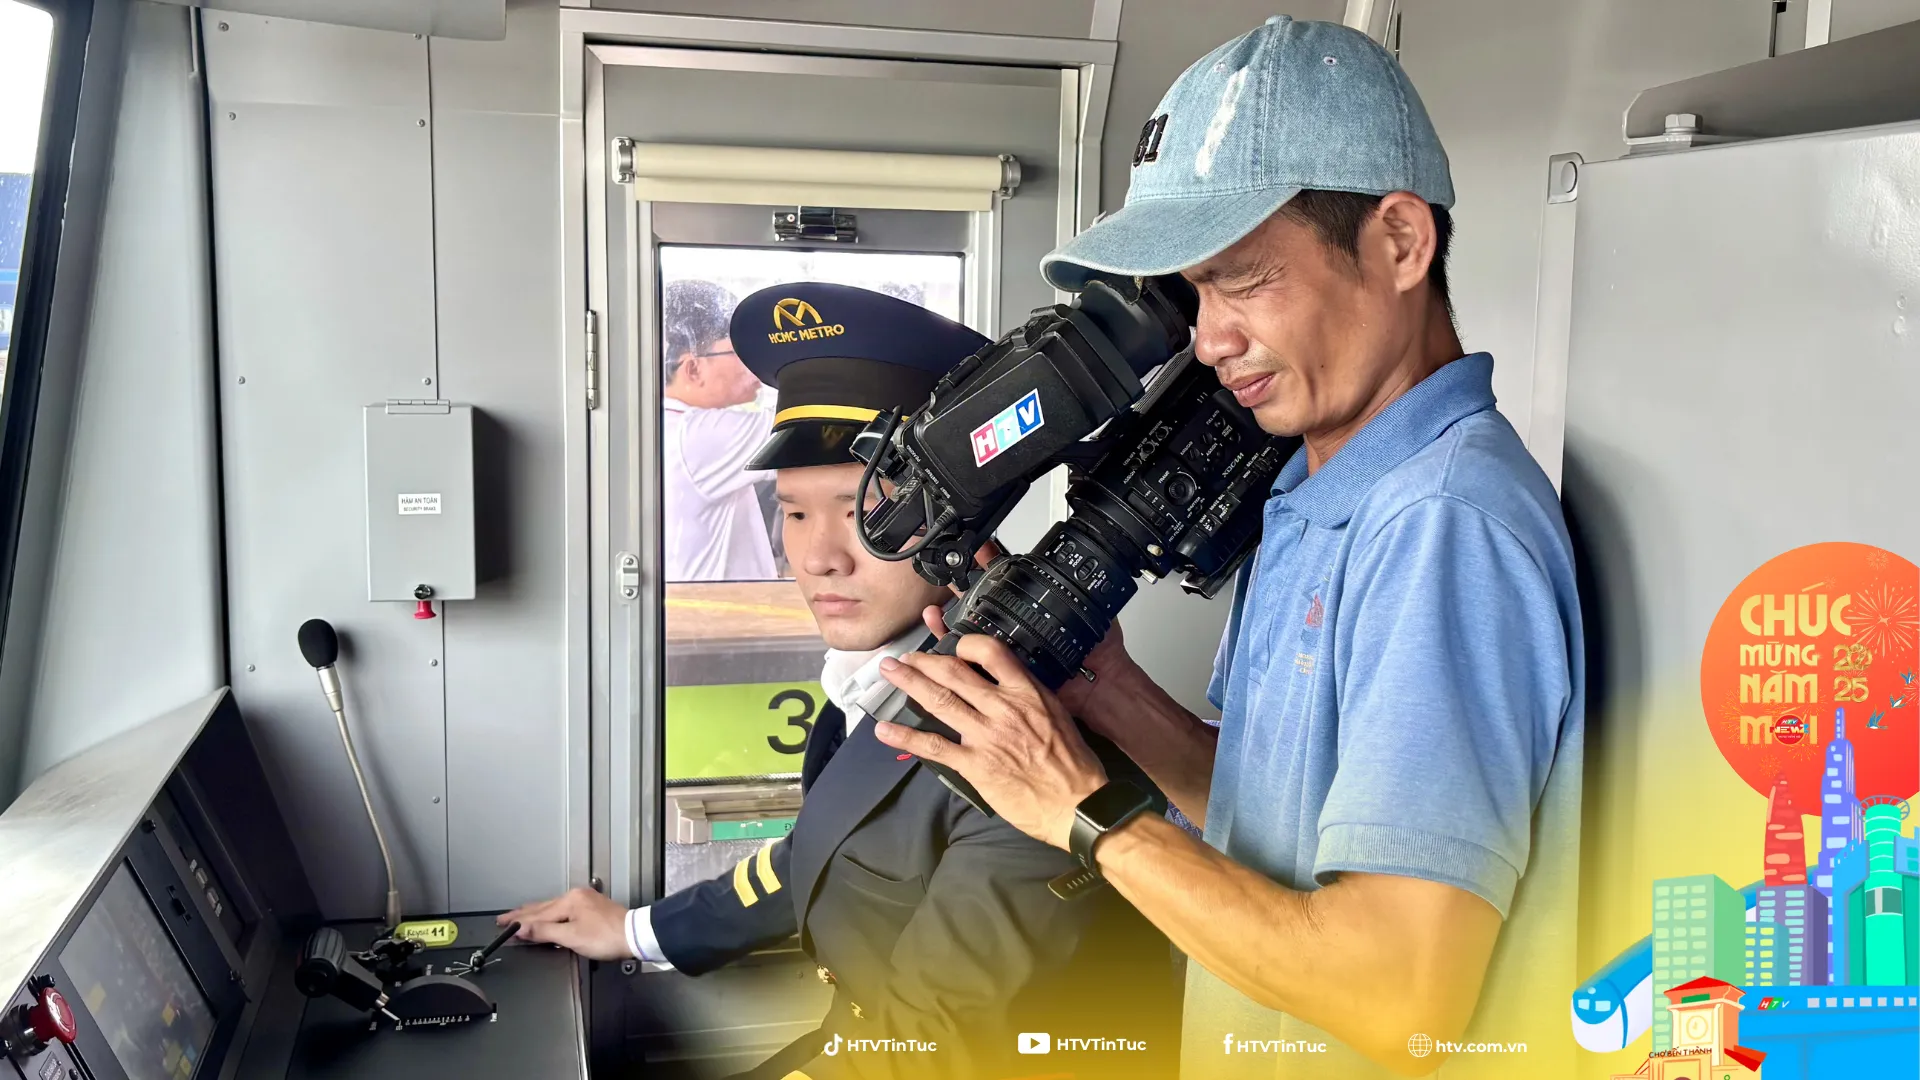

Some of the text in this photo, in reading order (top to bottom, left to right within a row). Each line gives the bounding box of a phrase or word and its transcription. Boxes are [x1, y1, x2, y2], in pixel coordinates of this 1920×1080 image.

[768, 323, 845, 344] HCMC METRO
[974, 394, 1040, 462] HTV
[1222, 452, 1245, 478] XDCAM
[767, 689, 816, 755] 3
[431, 926, 444, 936] 11
